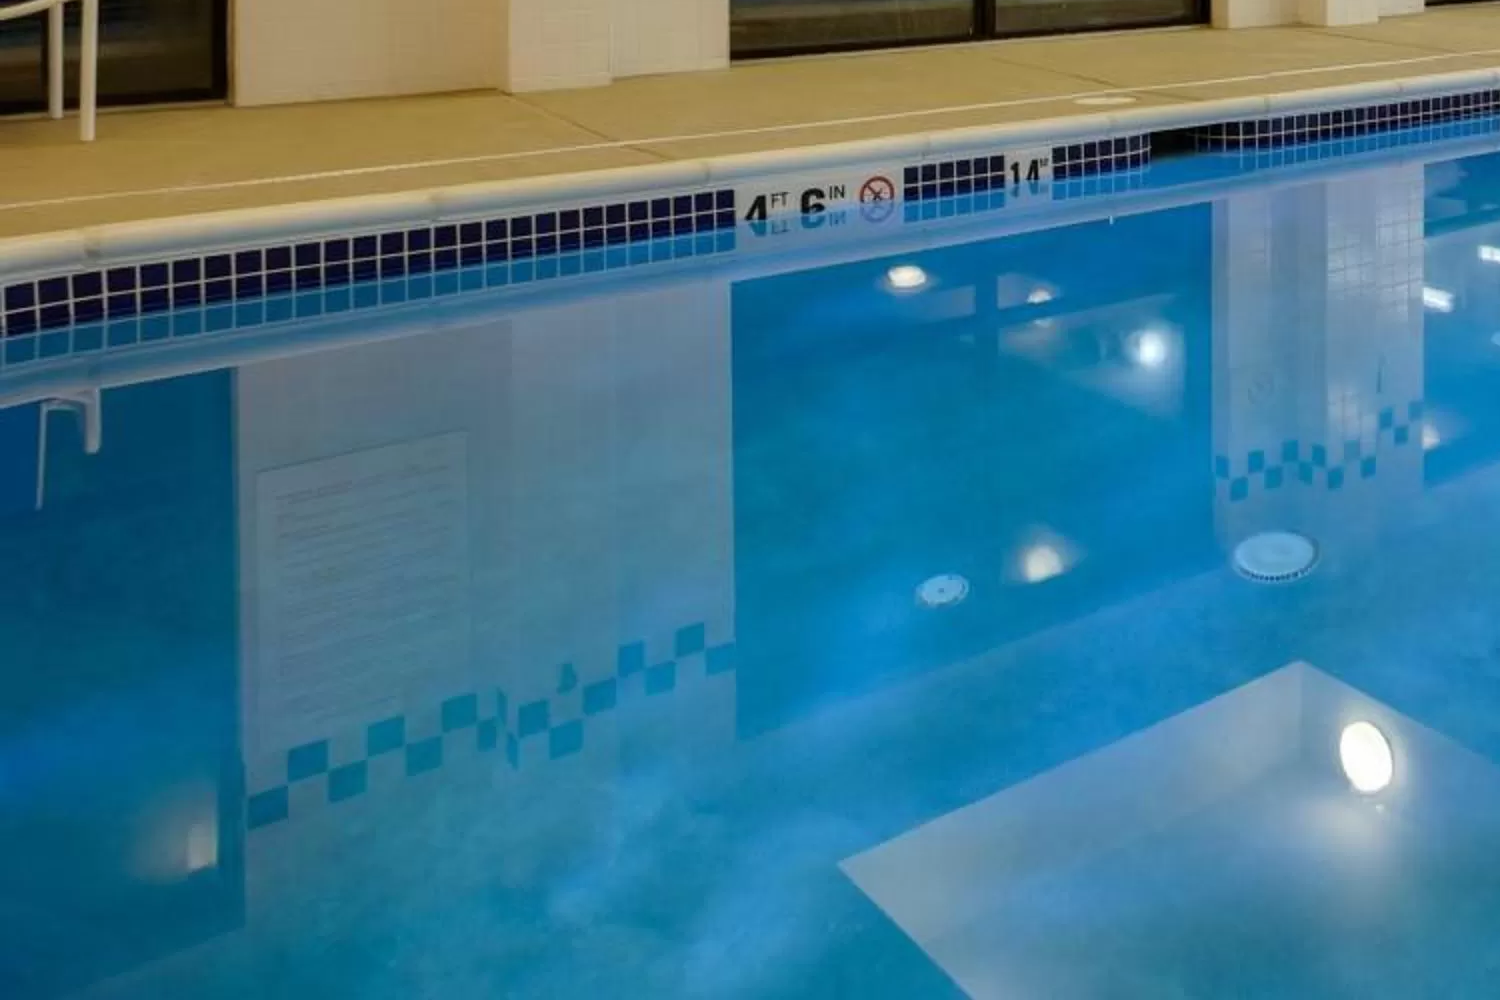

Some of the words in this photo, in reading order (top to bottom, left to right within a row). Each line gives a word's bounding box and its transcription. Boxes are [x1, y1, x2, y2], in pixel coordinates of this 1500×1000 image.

[744, 194, 768, 221] 4
[771, 191, 790, 208] FT
[800, 187, 827, 215] 6
[828, 184, 846, 200] IN
